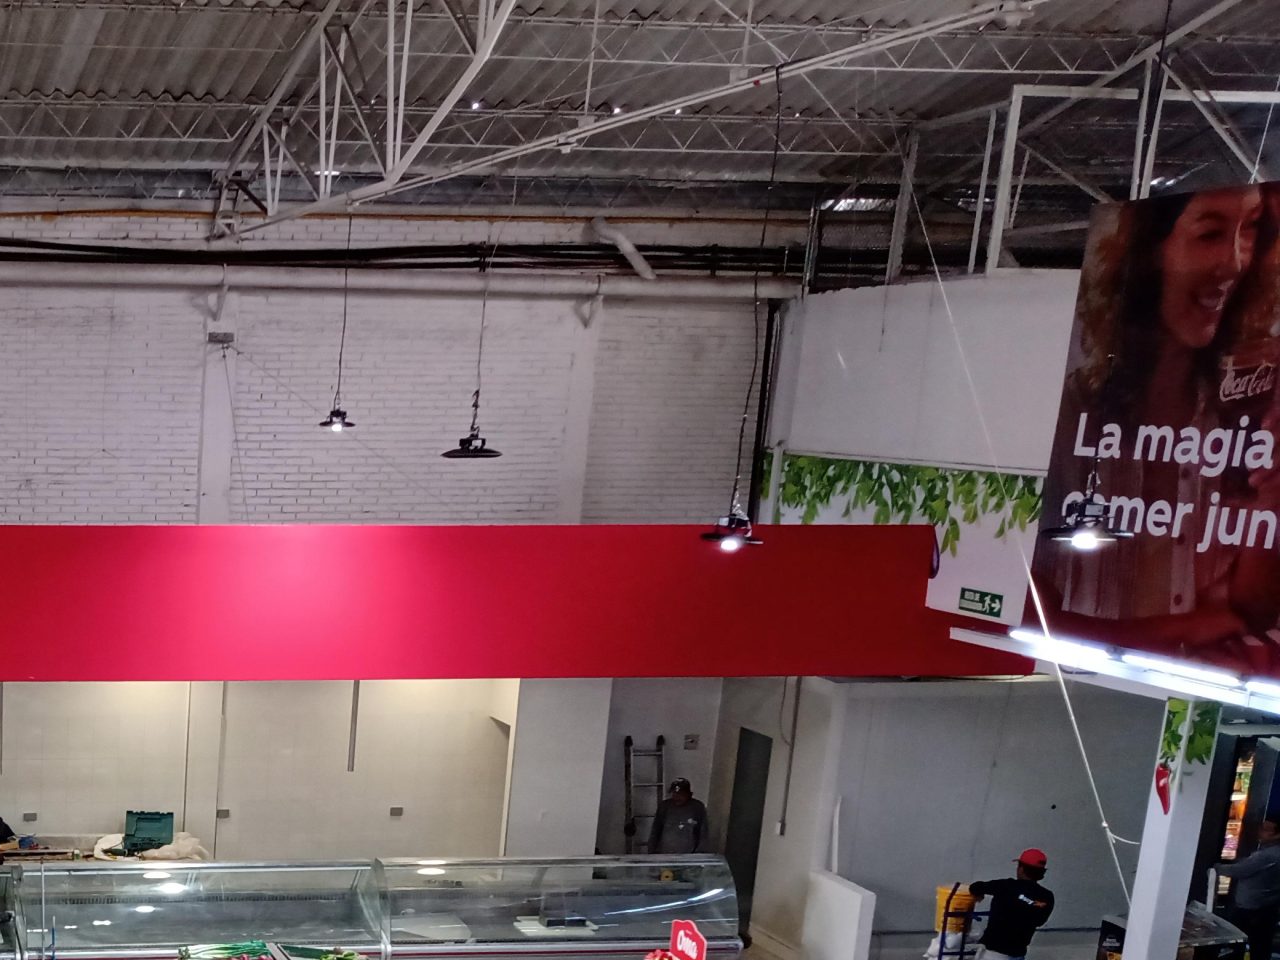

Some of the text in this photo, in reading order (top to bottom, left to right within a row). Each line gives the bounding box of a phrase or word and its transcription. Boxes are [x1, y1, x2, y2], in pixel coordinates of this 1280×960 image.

[1073, 412, 1275, 478] La magia
[1196, 491, 1277, 553] jun
[677, 929, 697, 960] Oma
